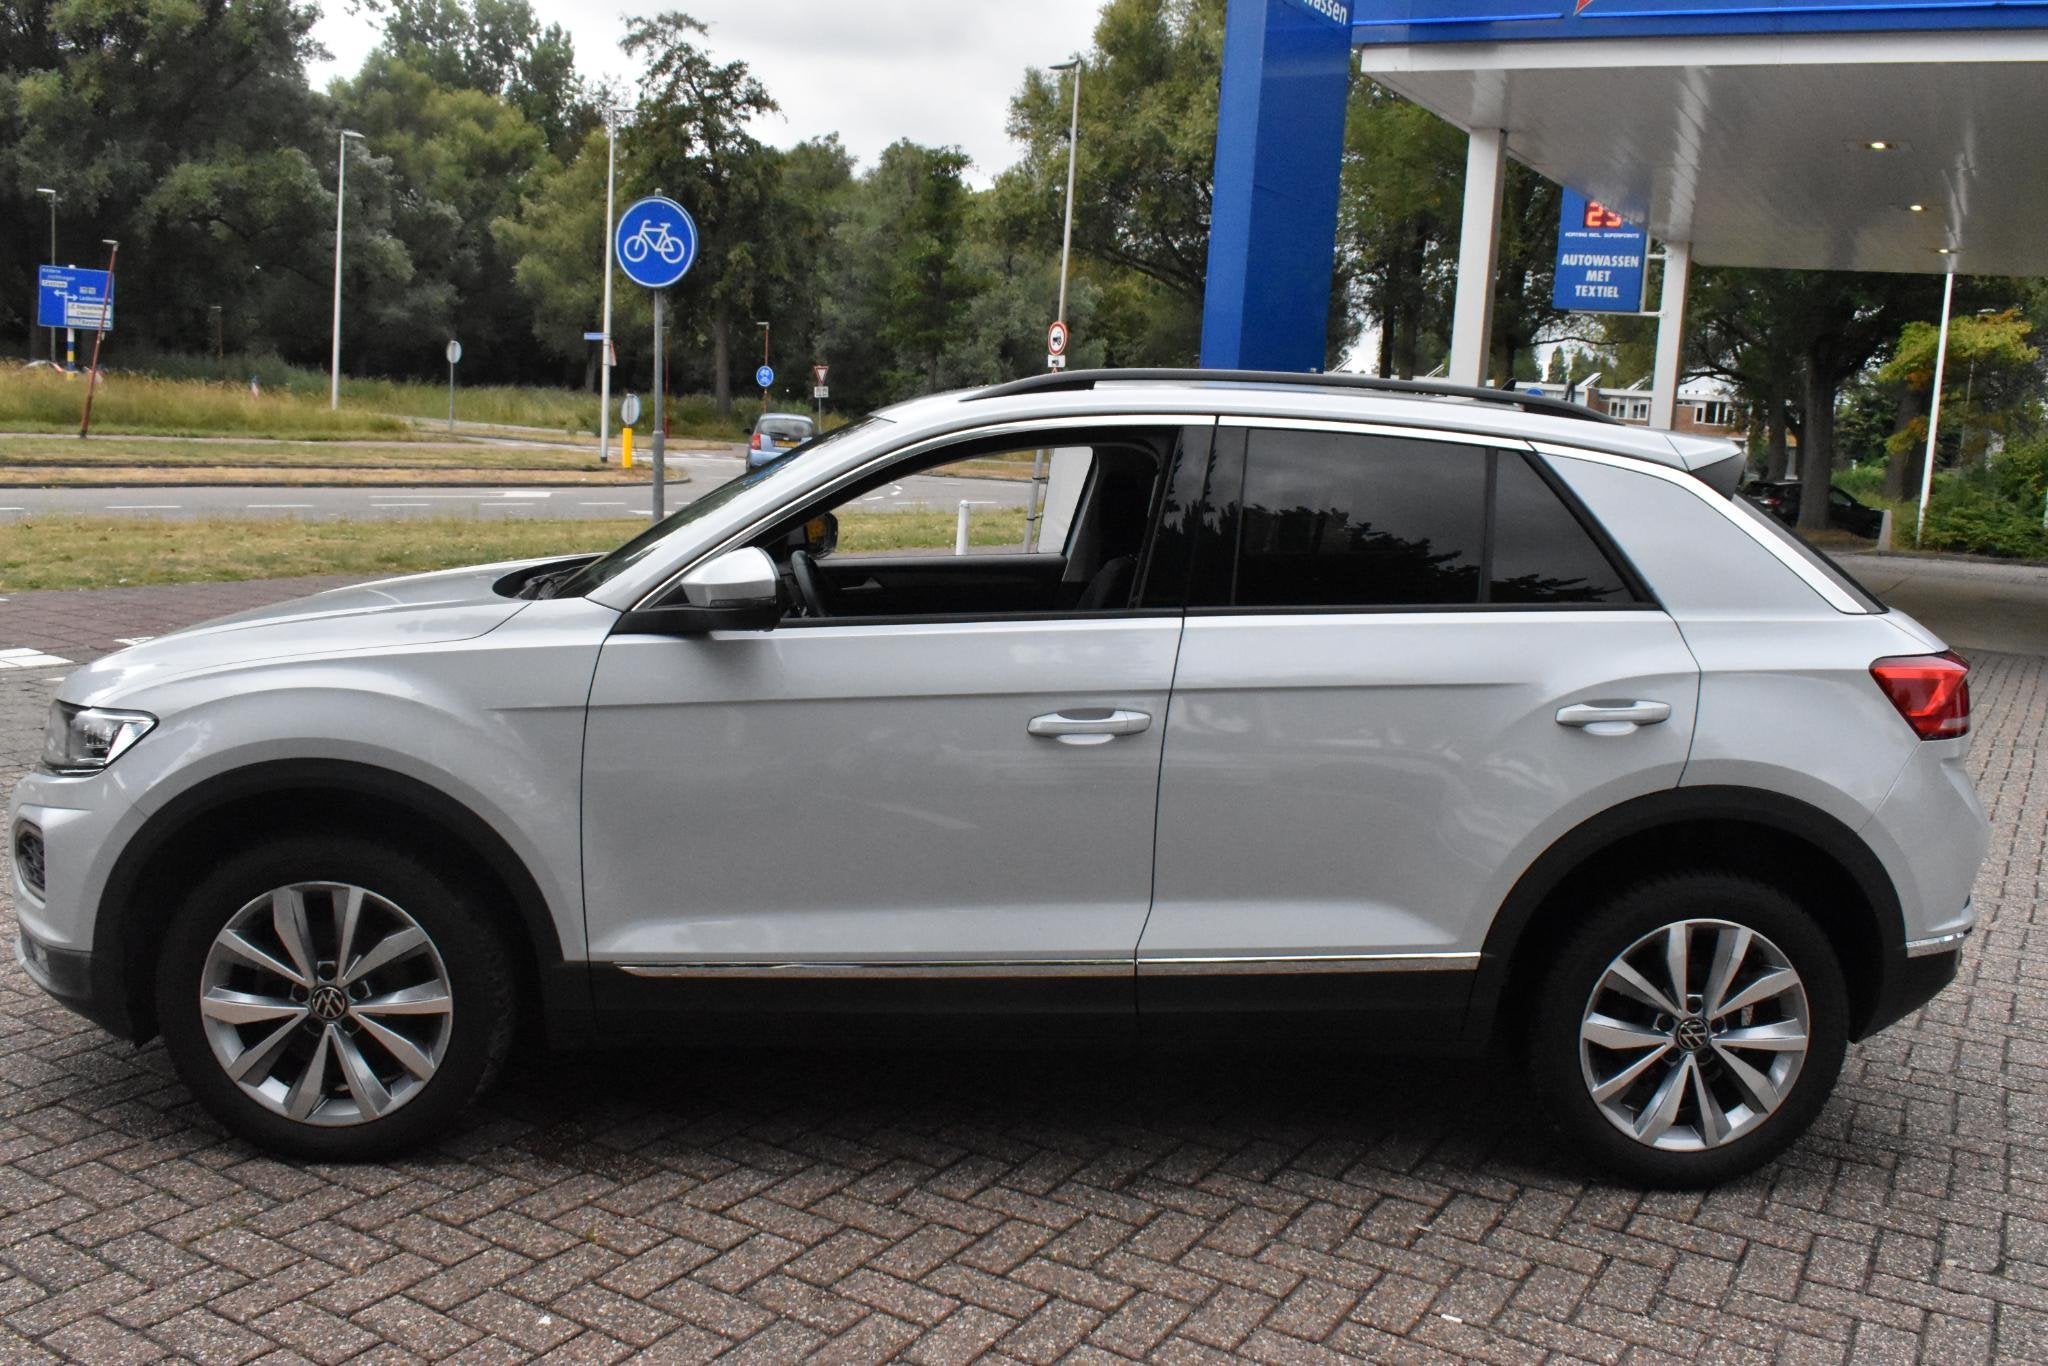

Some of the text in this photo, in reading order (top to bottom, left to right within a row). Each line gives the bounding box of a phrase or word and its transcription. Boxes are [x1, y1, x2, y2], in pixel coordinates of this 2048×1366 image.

[1303, 0, 1347, 26] assen
[1561, 254, 1640, 268] AUTOWASSEN
[1586, 270, 1612, 283] MET
[1575, 285, 1620, 298] TEXTIEL
